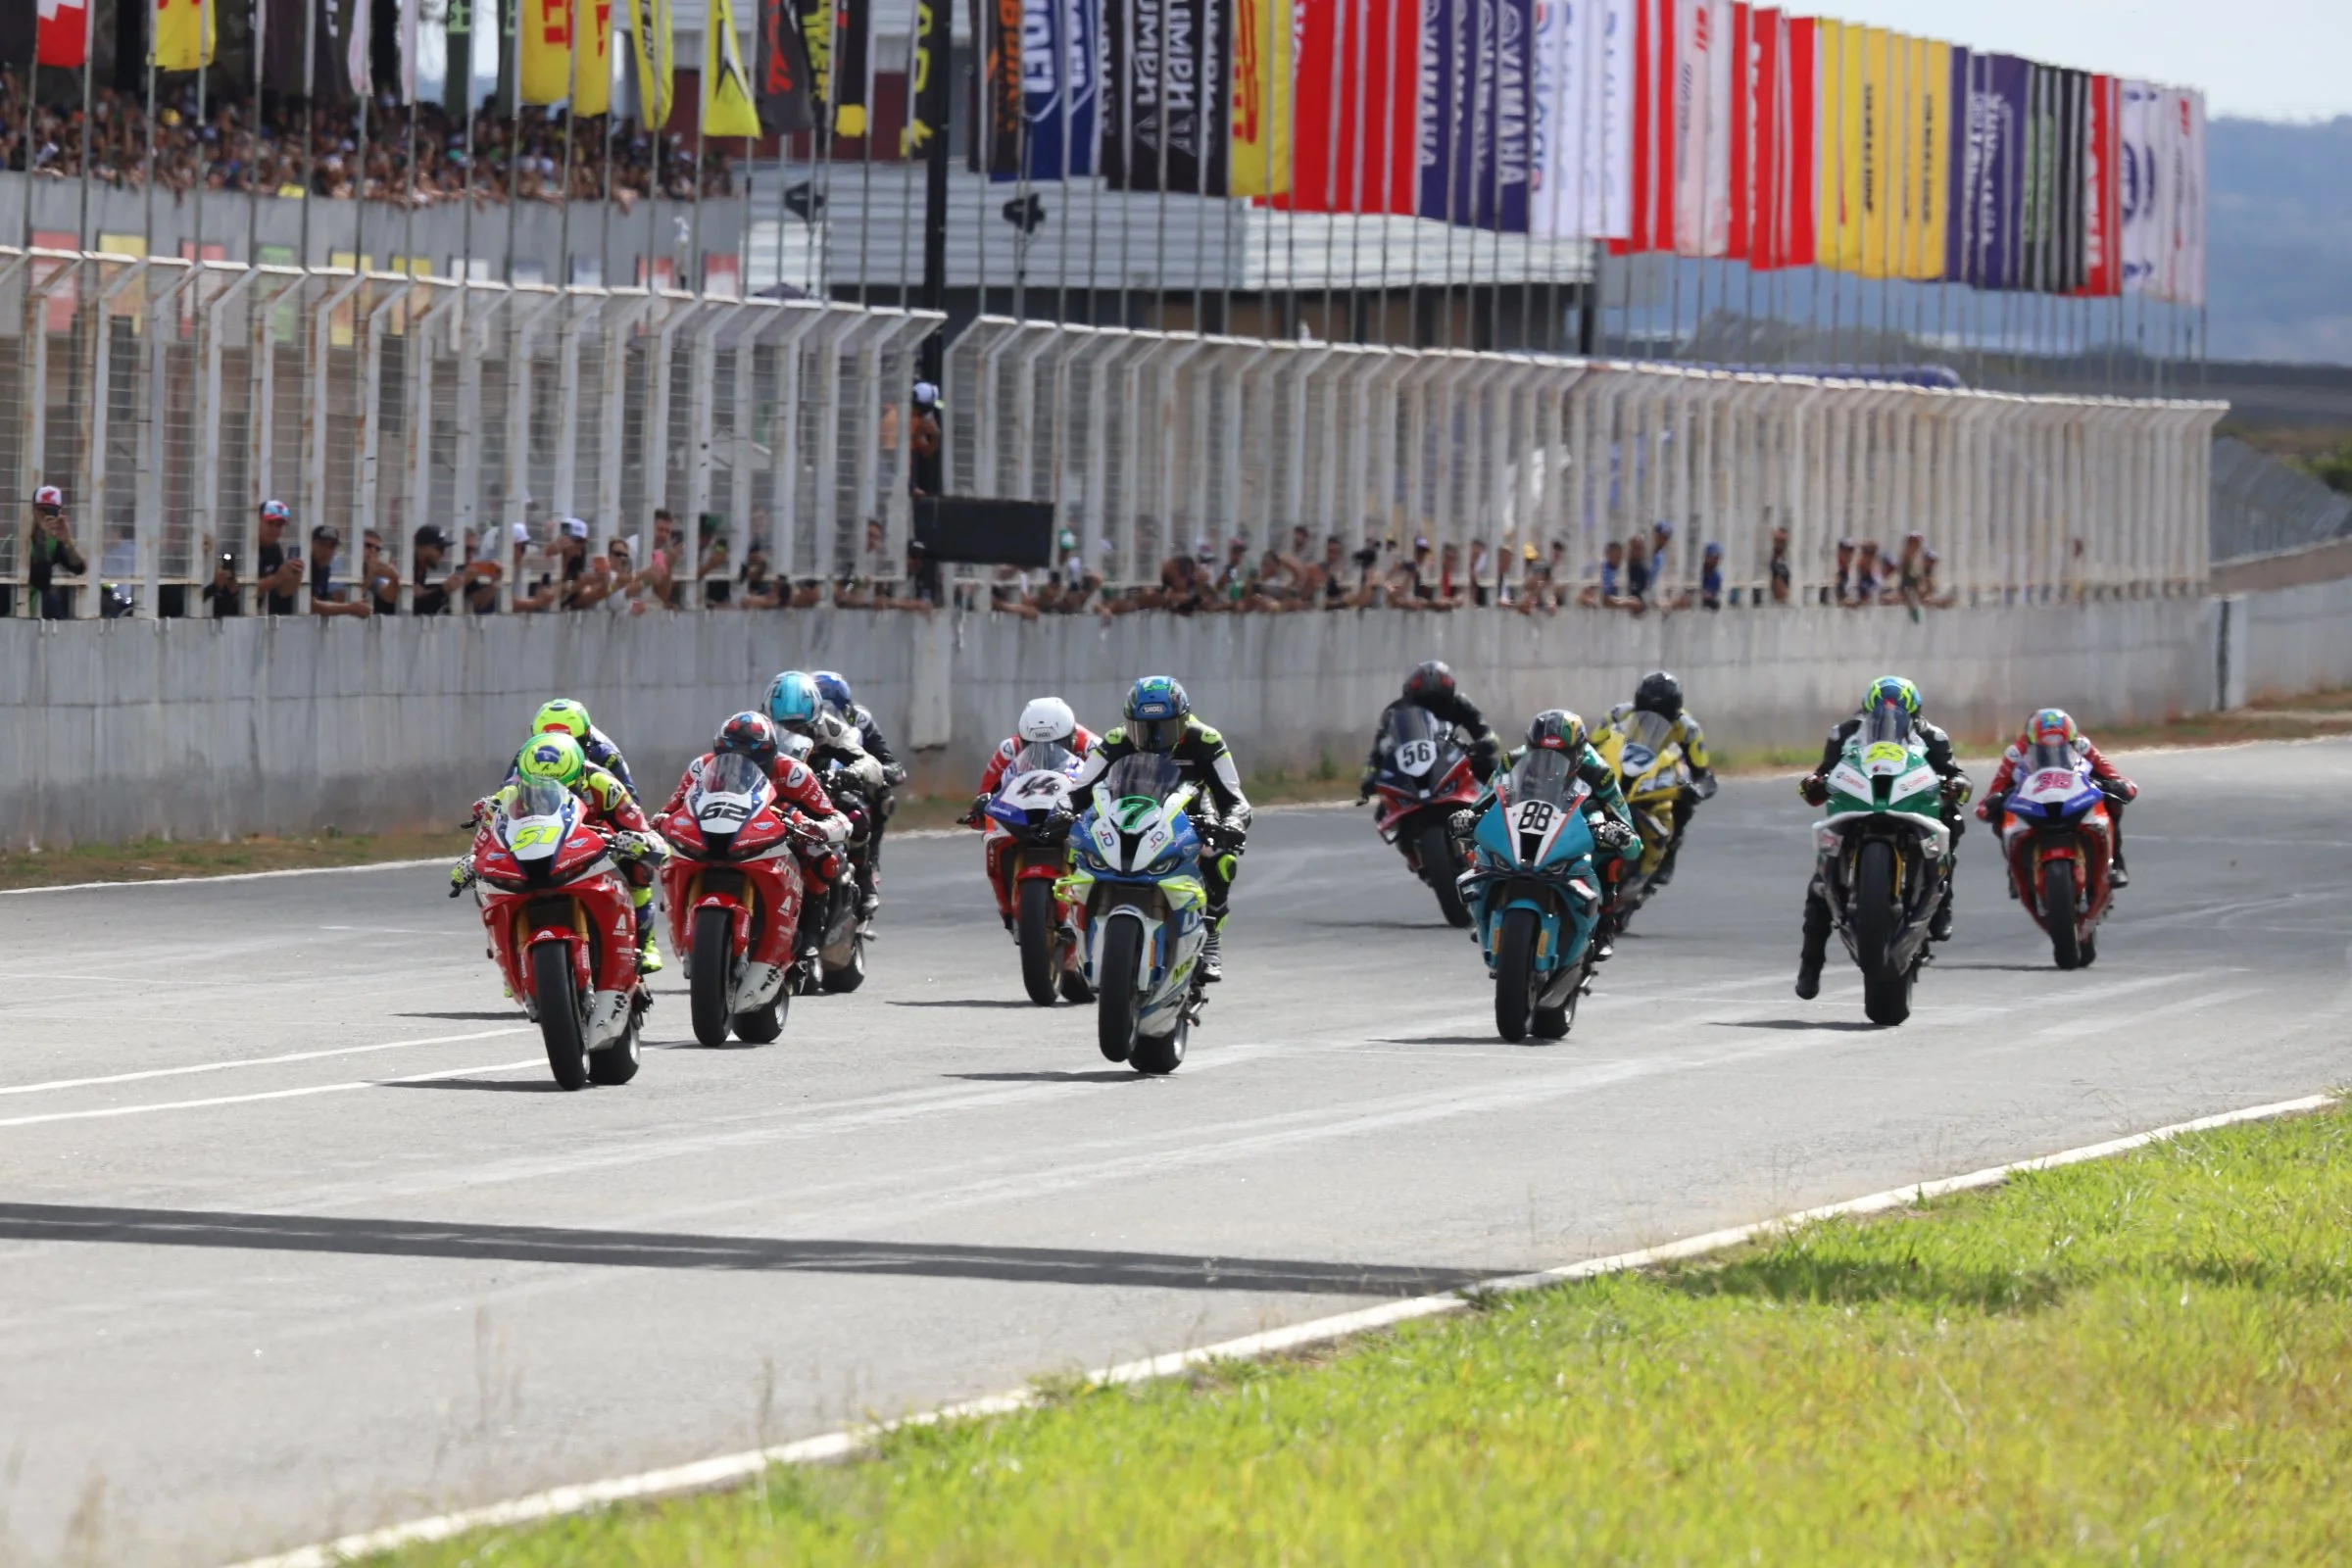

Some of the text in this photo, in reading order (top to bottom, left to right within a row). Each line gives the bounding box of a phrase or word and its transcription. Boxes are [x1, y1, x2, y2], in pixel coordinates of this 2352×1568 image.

[1498, 41, 1529, 186] YAMAHA
[1403, 742, 1431, 768] 56
[699, 801, 752, 823] 62
[1118, 795, 1157, 830] 7
[1518, 801, 1553, 832] 88
[510, 825, 563, 853] 51
